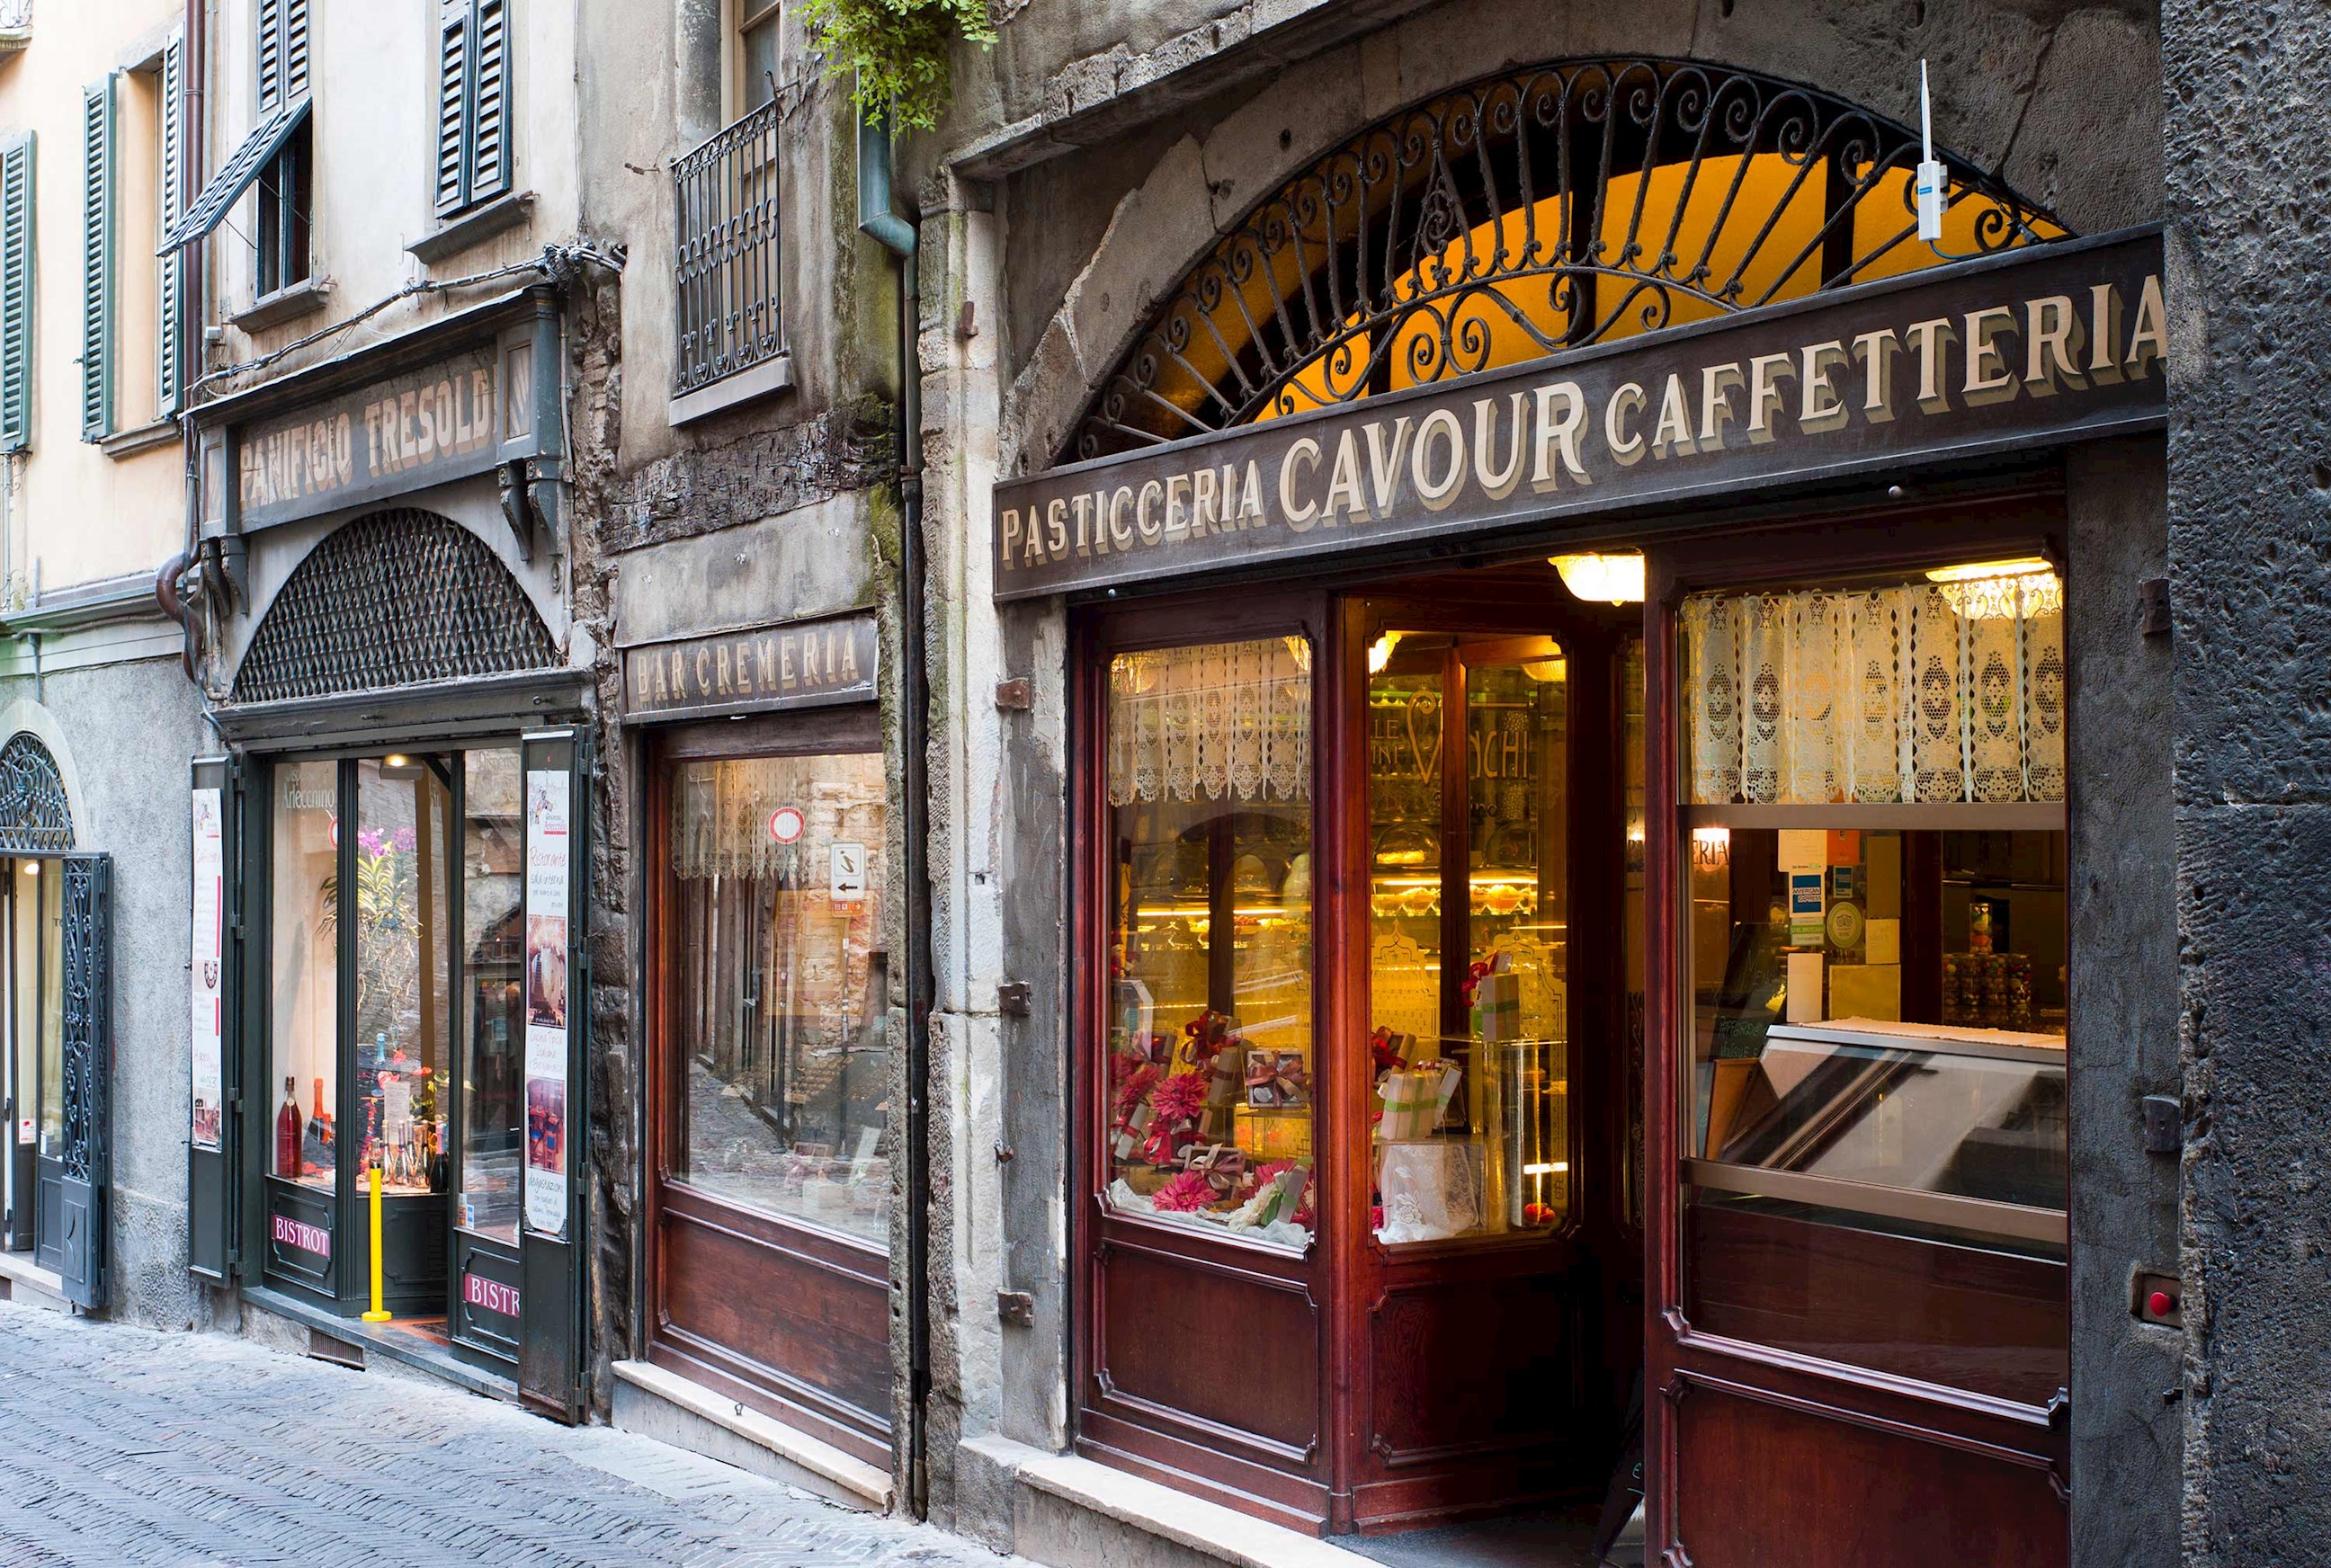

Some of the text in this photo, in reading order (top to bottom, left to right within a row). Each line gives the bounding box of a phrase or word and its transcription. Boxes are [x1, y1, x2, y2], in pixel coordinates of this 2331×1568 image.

[239, 413, 353, 510] PANIFICIO
[1001, 274, 2166, 570] PASTICCERIA CAVOUR CAFFETTERIA
[637, 628, 860, 702] BAR CREMERIA
[1407, 690, 1528, 785] VNCHI
[275, 1216, 328, 1255] BISTROT
[470, 1277, 520, 1316] BISTR
